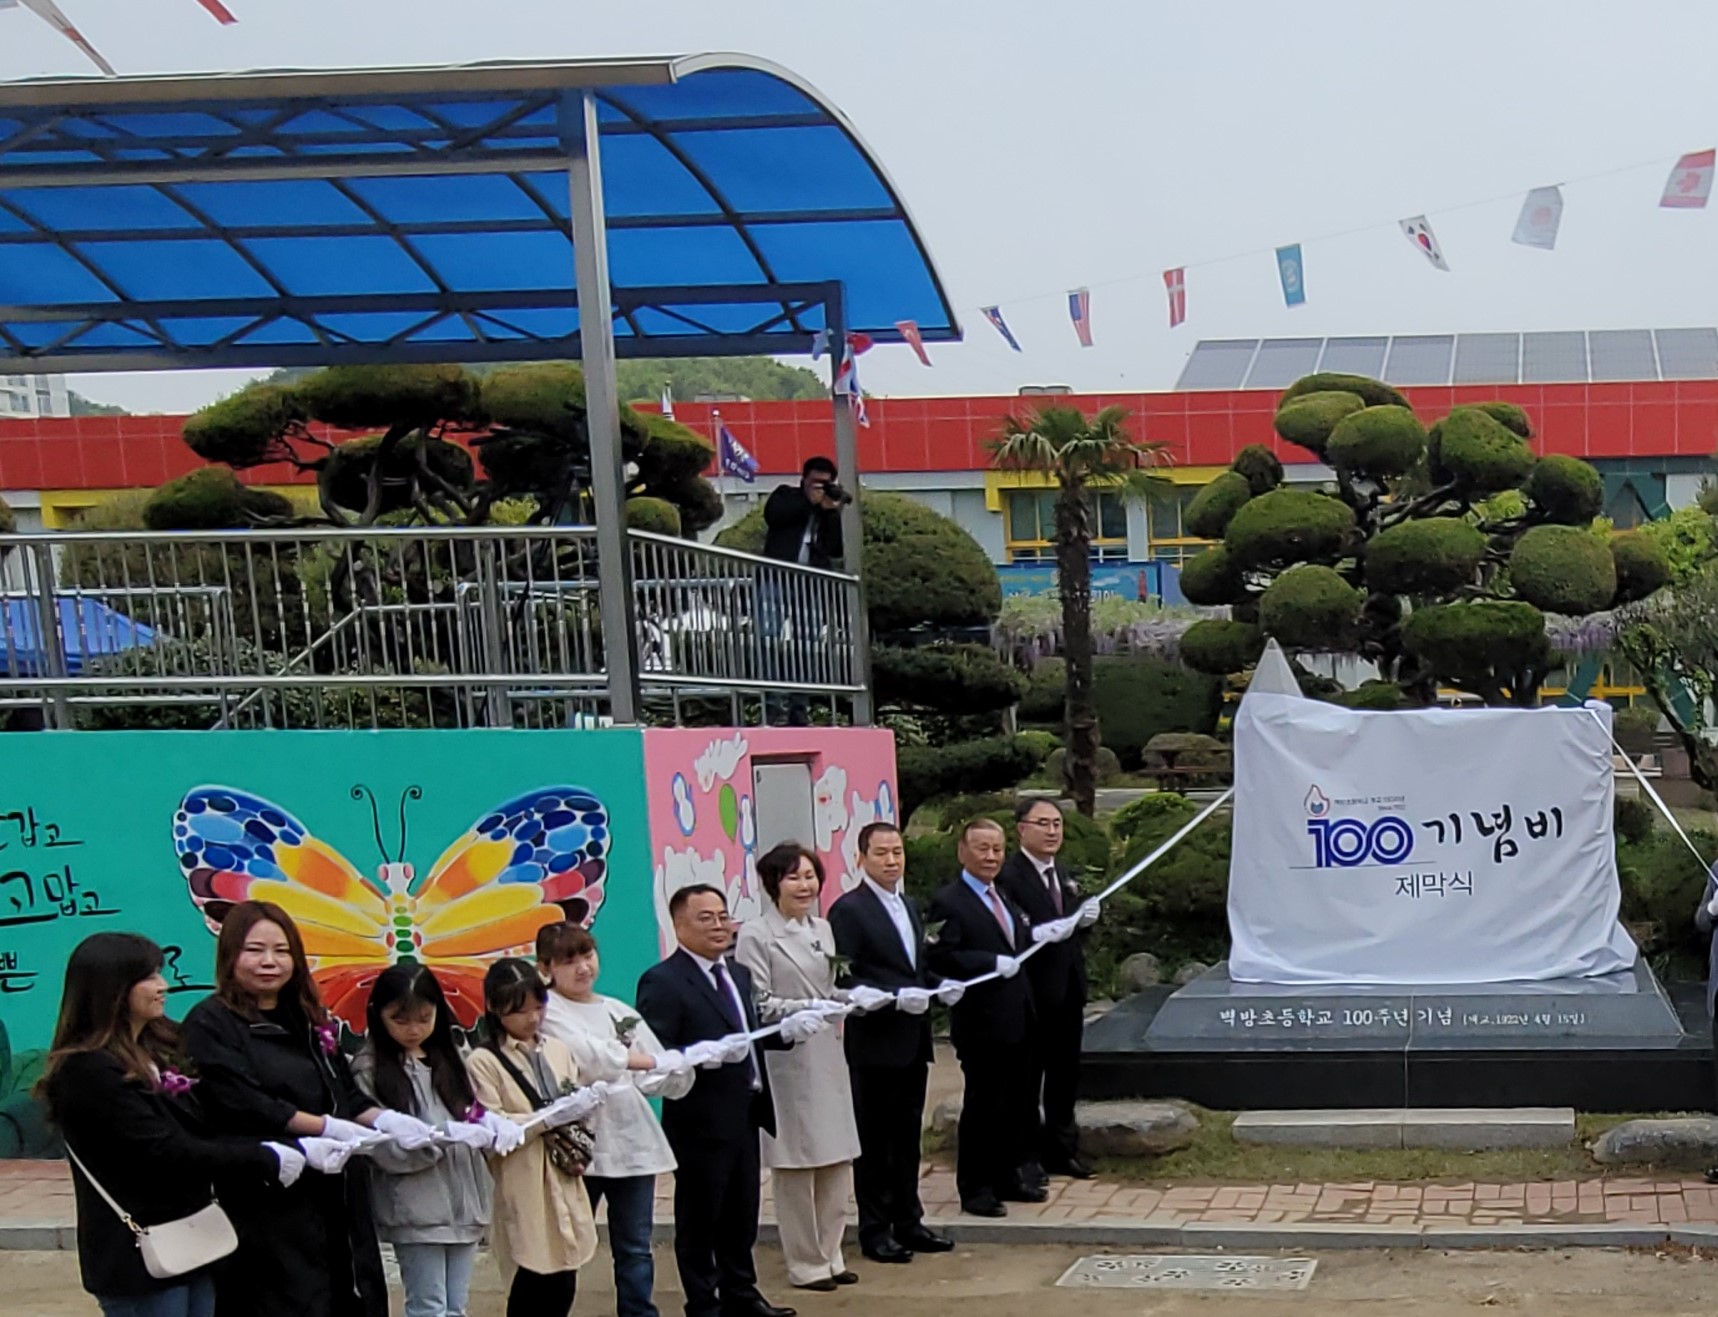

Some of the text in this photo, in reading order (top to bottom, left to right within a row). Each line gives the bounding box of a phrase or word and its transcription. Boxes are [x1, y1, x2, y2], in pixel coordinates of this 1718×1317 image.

[0, 806, 84, 848] 갑고
[1307, 804, 1564, 867] 100 기념비
[1395, 871, 1474, 898] 제막식
[1219, 1008, 1334, 1028] 벽방초등학교
[1343, 1008, 1409, 1027] 100주년
[1418, 1007, 1452, 1026] 기념
